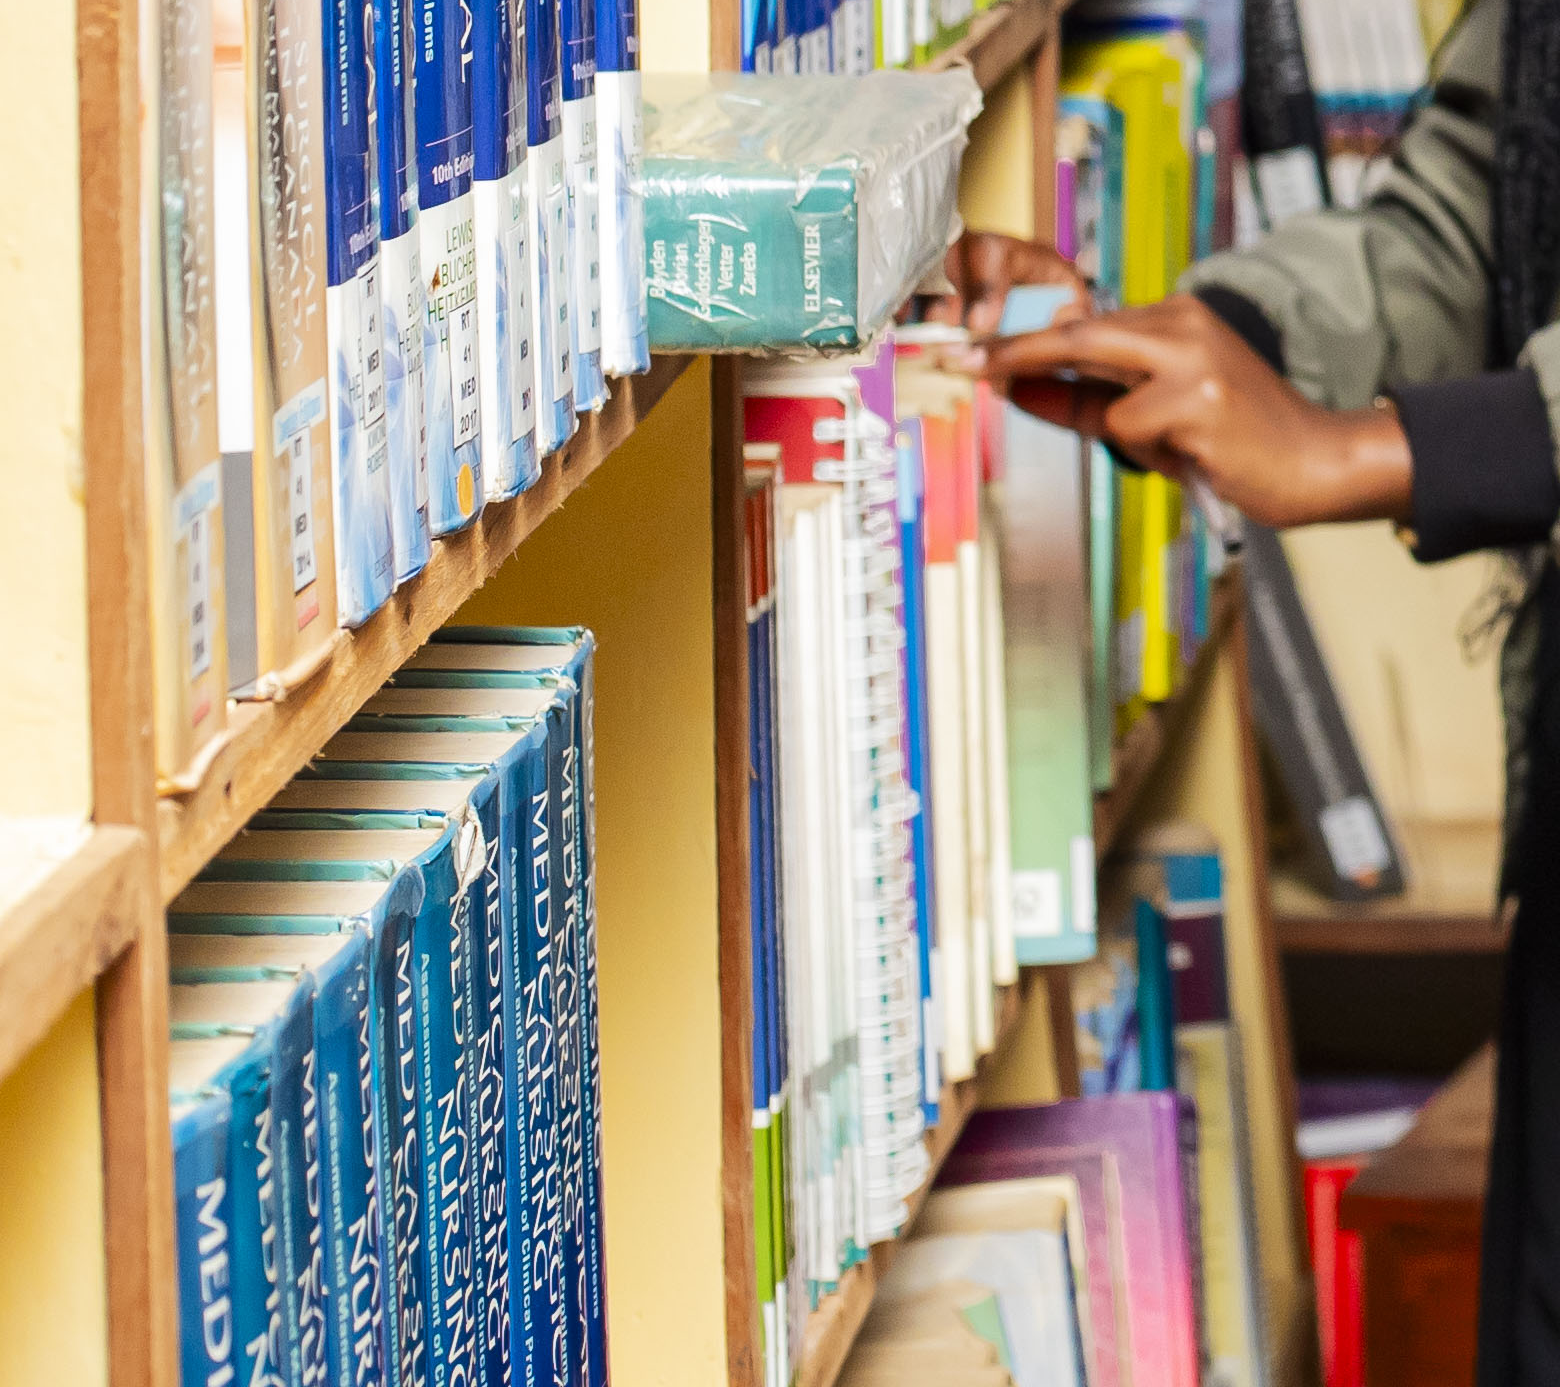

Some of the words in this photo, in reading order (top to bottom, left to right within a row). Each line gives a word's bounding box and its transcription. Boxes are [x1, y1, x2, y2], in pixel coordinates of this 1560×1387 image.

[718, 244, 734, 290] Vetter
[739, 242, 757, 295] Zareba
[804, 224, 821, 312] ELSEVIER
[461, 310, 470, 332] RT
[463, 347, 472, 363] 41
[461, 376, 476, 399] MED
[459, 412, 477, 434] 2017
